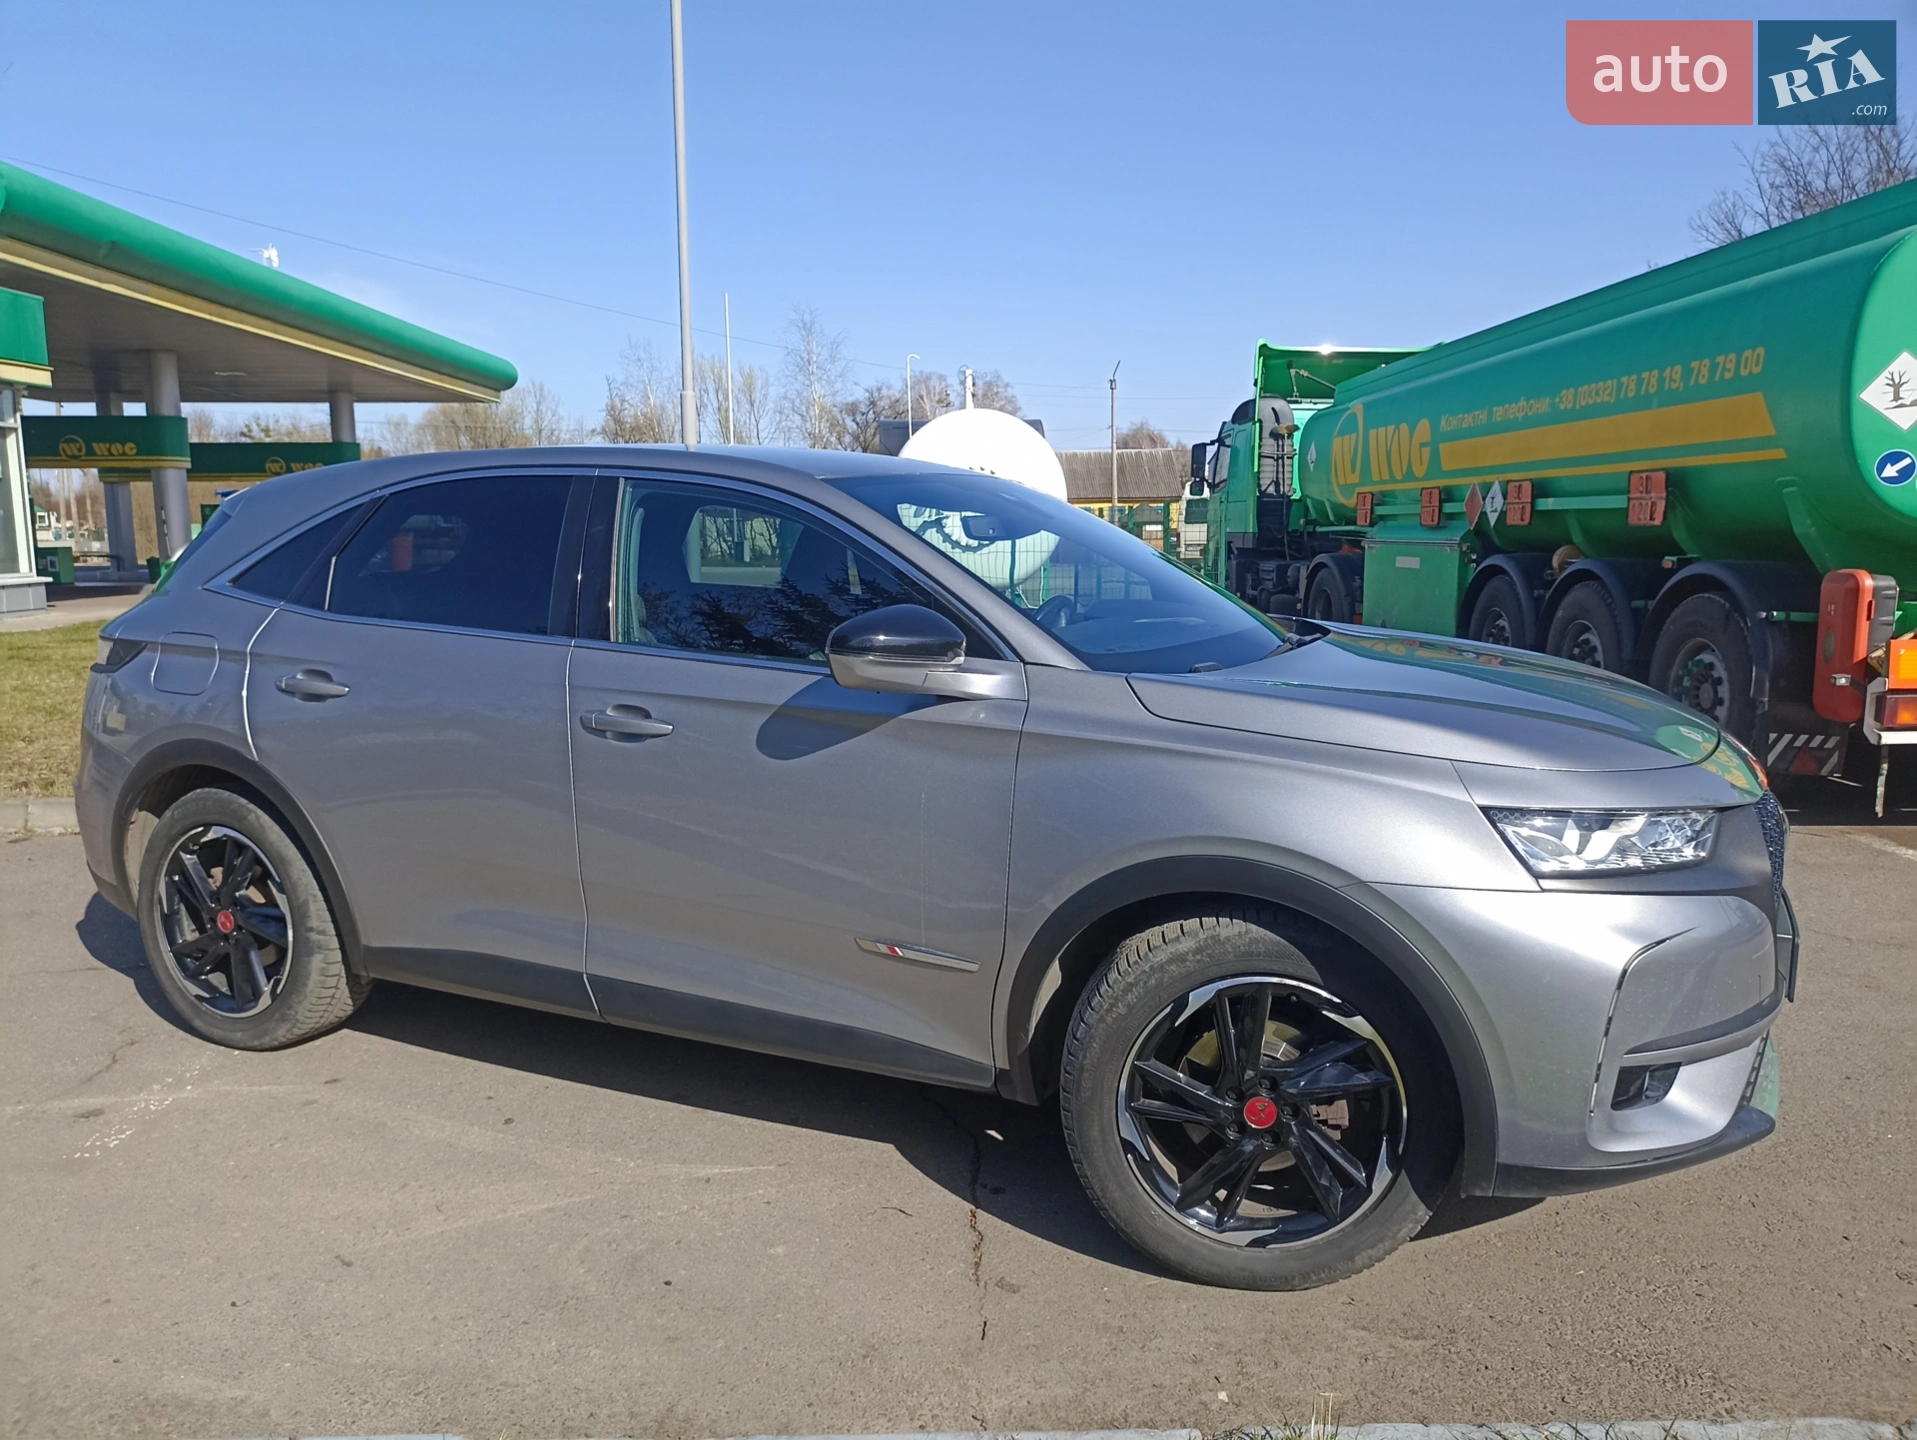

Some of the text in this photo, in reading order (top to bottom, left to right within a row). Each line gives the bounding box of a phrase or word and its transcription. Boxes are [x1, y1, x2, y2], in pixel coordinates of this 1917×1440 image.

[1440, 406, 1488, 432] Контактні
[1492, 397, 1552, 422] телефони:
[1620, 374, 1637, 399] 78
[1641, 369, 1659, 395] 78
[1663, 364, 1684, 392] 19,
[1689, 358, 1711, 386] 78
[1715, 352, 1737, 382] 79
[1740, 346, 1766, 377] 00
[1369, 418, 1431, 481] WOG
